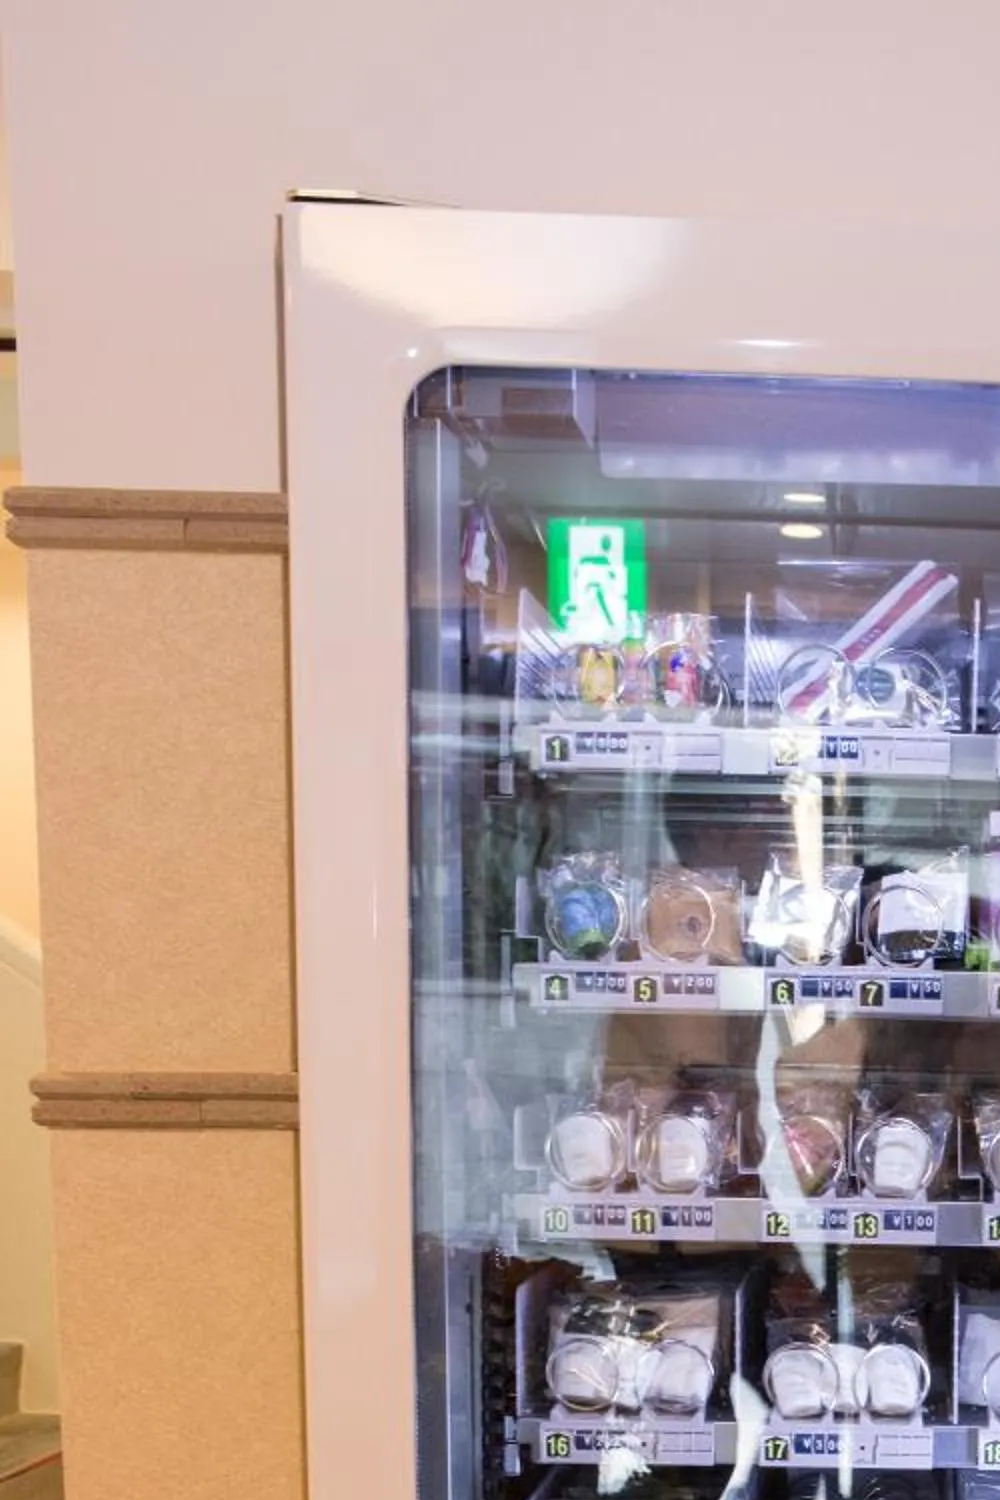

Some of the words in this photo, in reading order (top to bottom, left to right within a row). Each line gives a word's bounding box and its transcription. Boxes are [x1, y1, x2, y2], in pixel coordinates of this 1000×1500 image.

[551, 739, 561, 760] 1
[549, 979, 561, 1000] 4
[639, 980, 651, 1001] 5
[776, 982, 789, 1002] 6
[865, 984, 878, 1005] 7
[545, 1210, 567, 1231] 10
[632, 1212, 654, 1233] 11
[767, 1214, 790, 1236] 12
[854, 1216, 877, 1237] 13
[547, 1436, 569, 1457] 16
[766, 1440, 788, 1460] 17
